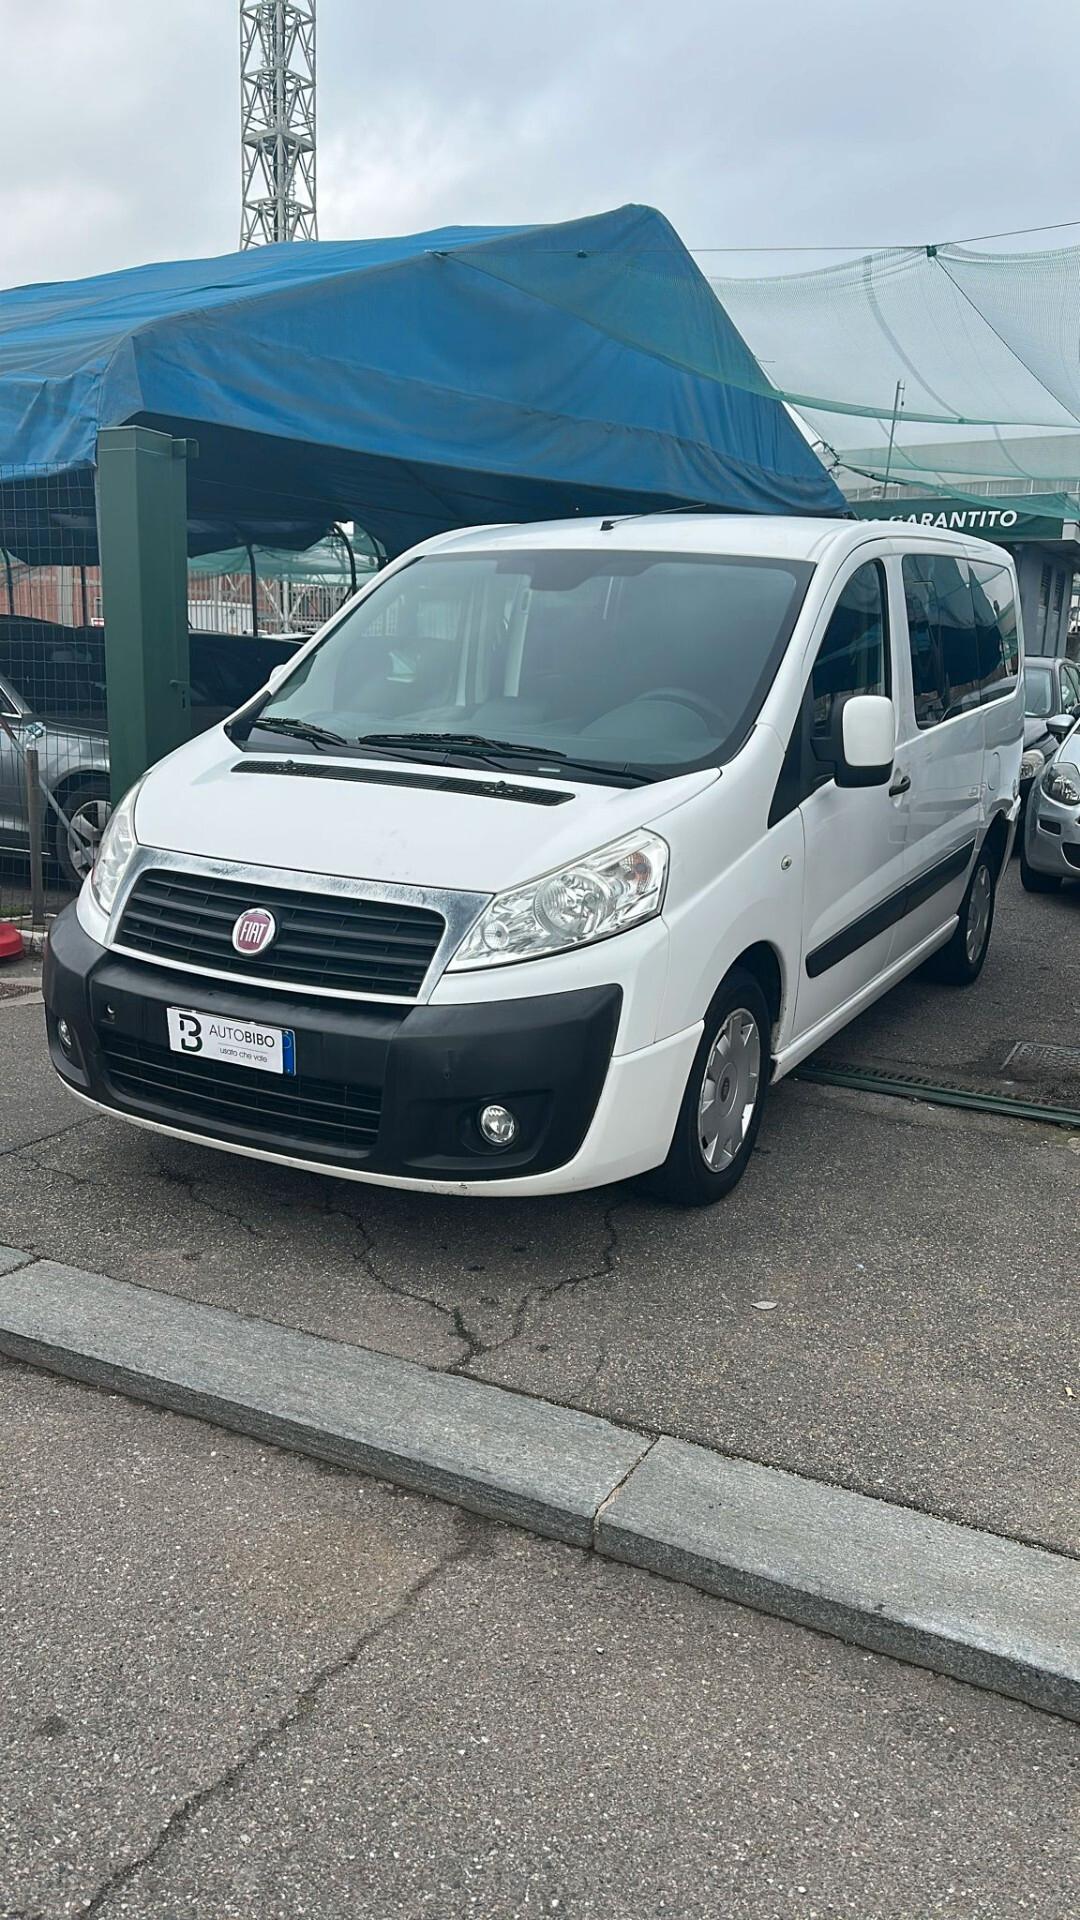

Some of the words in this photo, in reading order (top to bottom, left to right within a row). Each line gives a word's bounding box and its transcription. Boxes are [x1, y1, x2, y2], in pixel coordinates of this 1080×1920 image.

[240, 921, 267, 944] FIAT
[209, 1024, 275, 1048] AUTOBIBO
[219, 1047, 238, 1057] usato
[238, 1051, 252, 1060] che
[253, 1054, 268, 1063] vale
